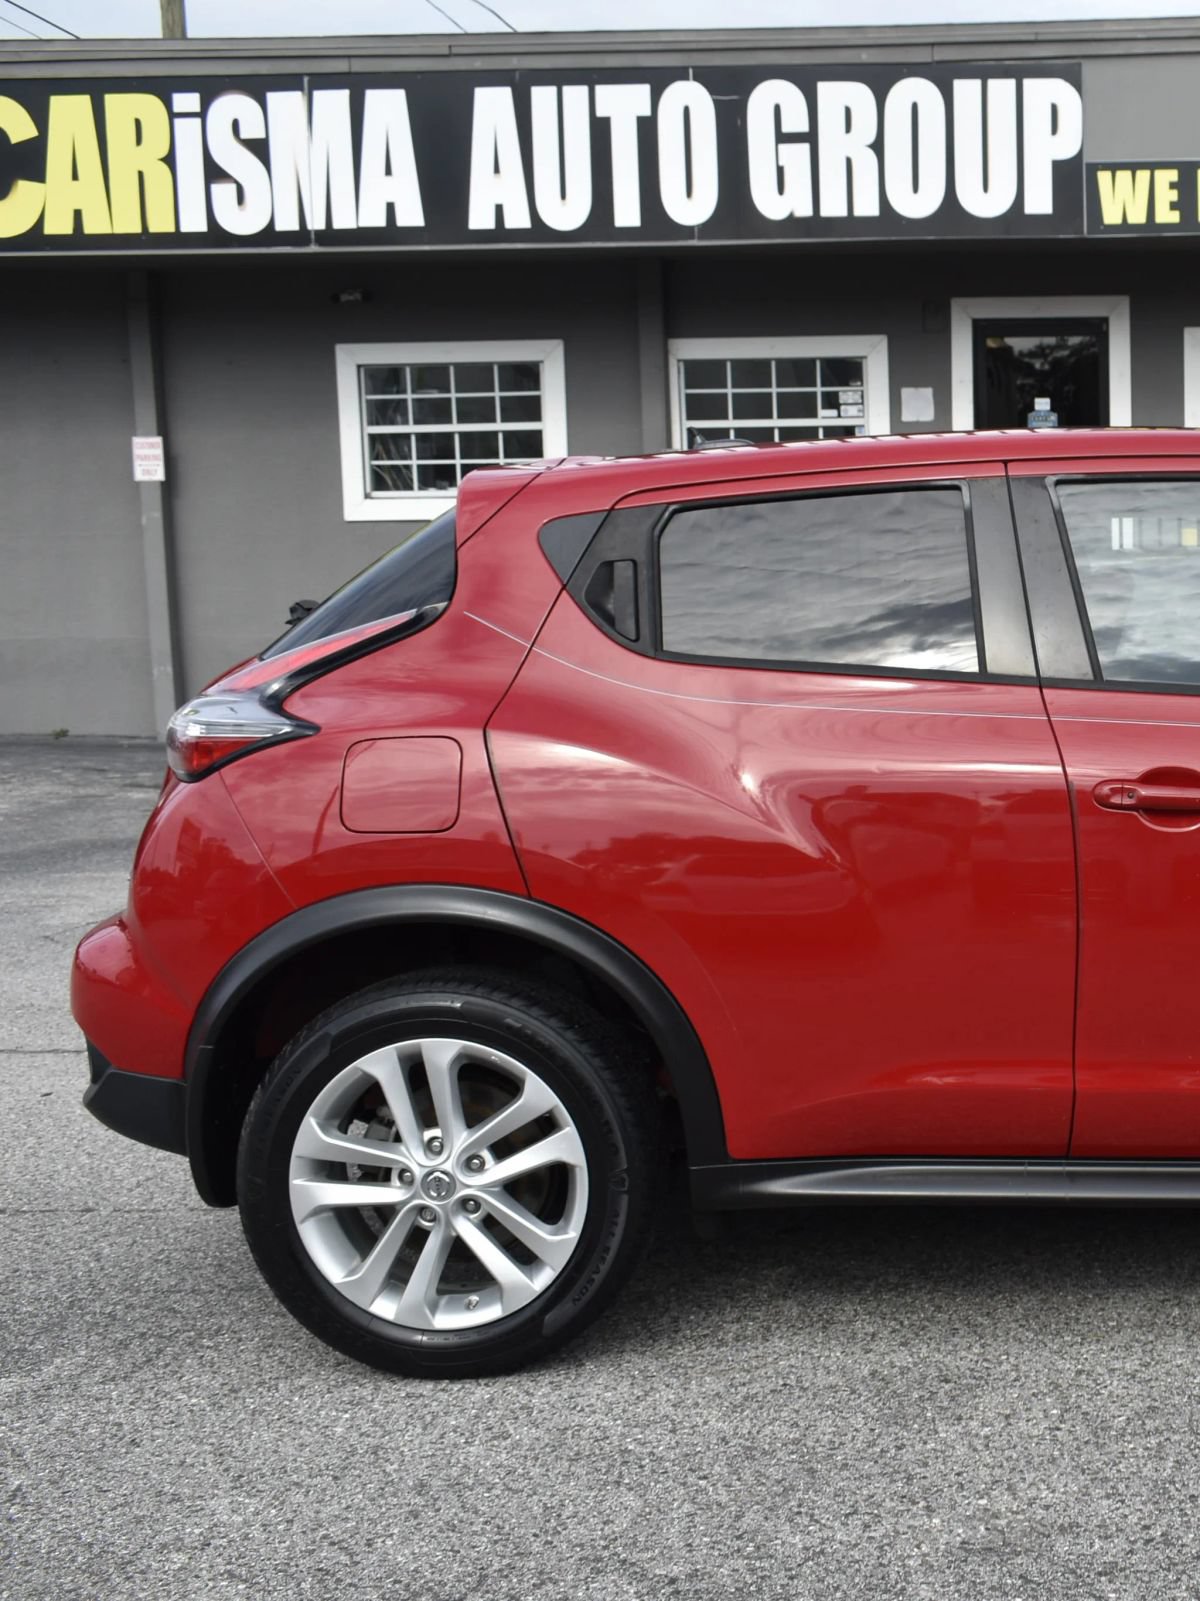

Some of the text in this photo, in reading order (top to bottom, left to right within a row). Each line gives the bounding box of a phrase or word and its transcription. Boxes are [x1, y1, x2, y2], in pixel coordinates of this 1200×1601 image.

[468, 79, 719, 232] AUTO
[746, 77, 1083, 221] GROUP
[1096, 168, 1181, 225] WE
